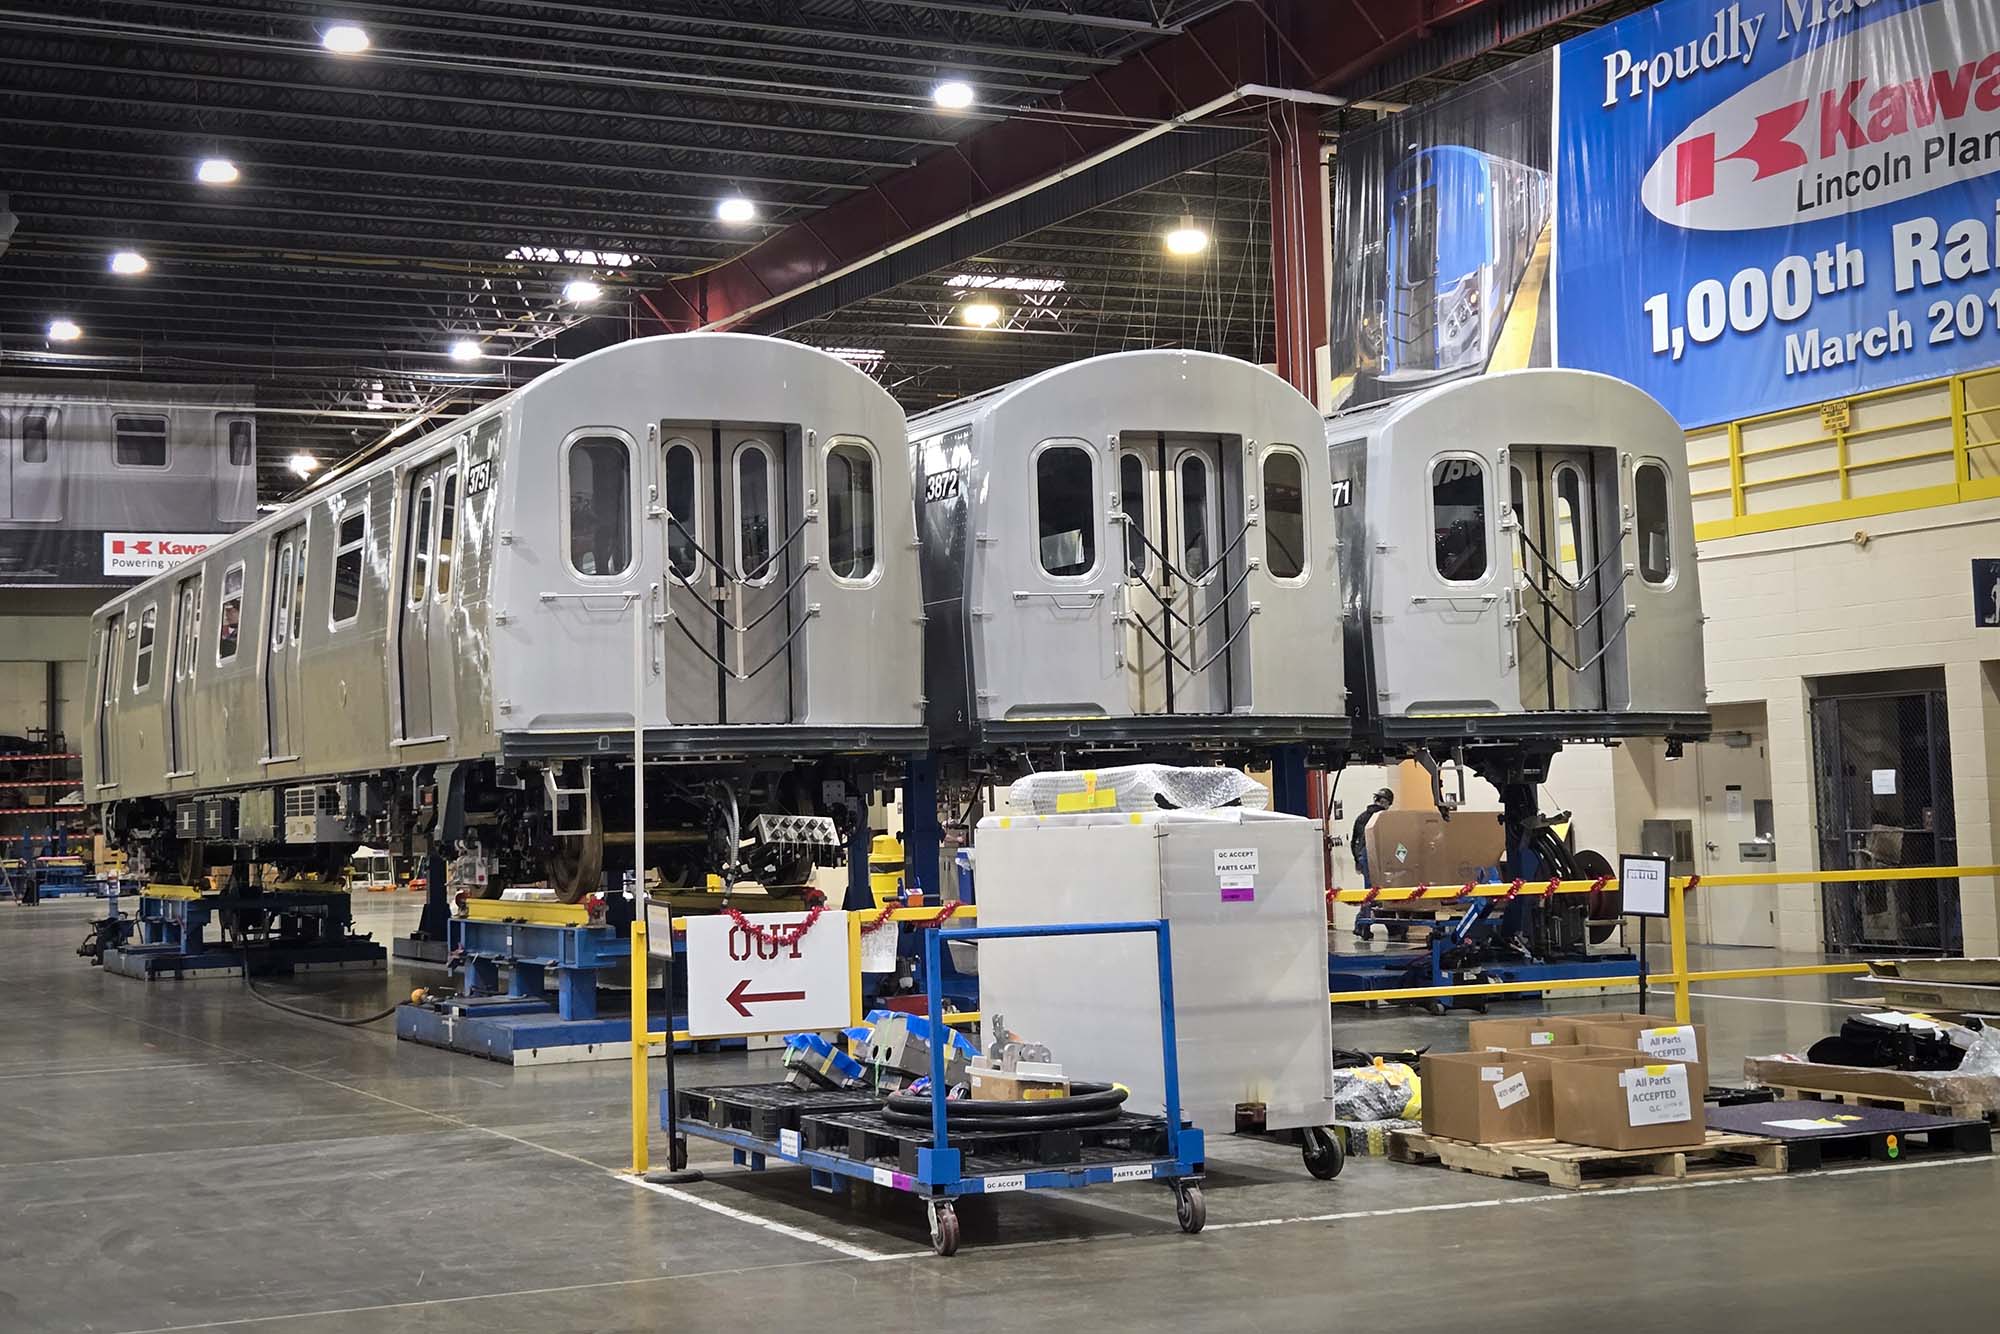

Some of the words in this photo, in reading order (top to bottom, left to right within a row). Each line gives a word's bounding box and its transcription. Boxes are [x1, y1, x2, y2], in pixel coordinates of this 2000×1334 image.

[1602, 2, 1765, 107] Proudly
[1797, 152, 1911, 212] Lincoln
[1643, 241, 1865, 360] 1,000th
[1785, 310, 1912, 375] March
[468, 461, 490, 494] 3751
[927, 470, 957, 500] 3872
[112, 558, 164, 570] Powering
[957, 710, 963, 722] 2
[729, 923, 804, 961] OUT
[1650, 1037, 1660, 1047] All
[1661, 1036, 1681, 1045] Parts
[1632, 1090, 1677, 1103] ACCEPTED
[1635, 1077, 1647, 1088] All
[1649, 1076, 1671, 1087] Parts
[998, 1180, 1023, 1188] ACCEPT
